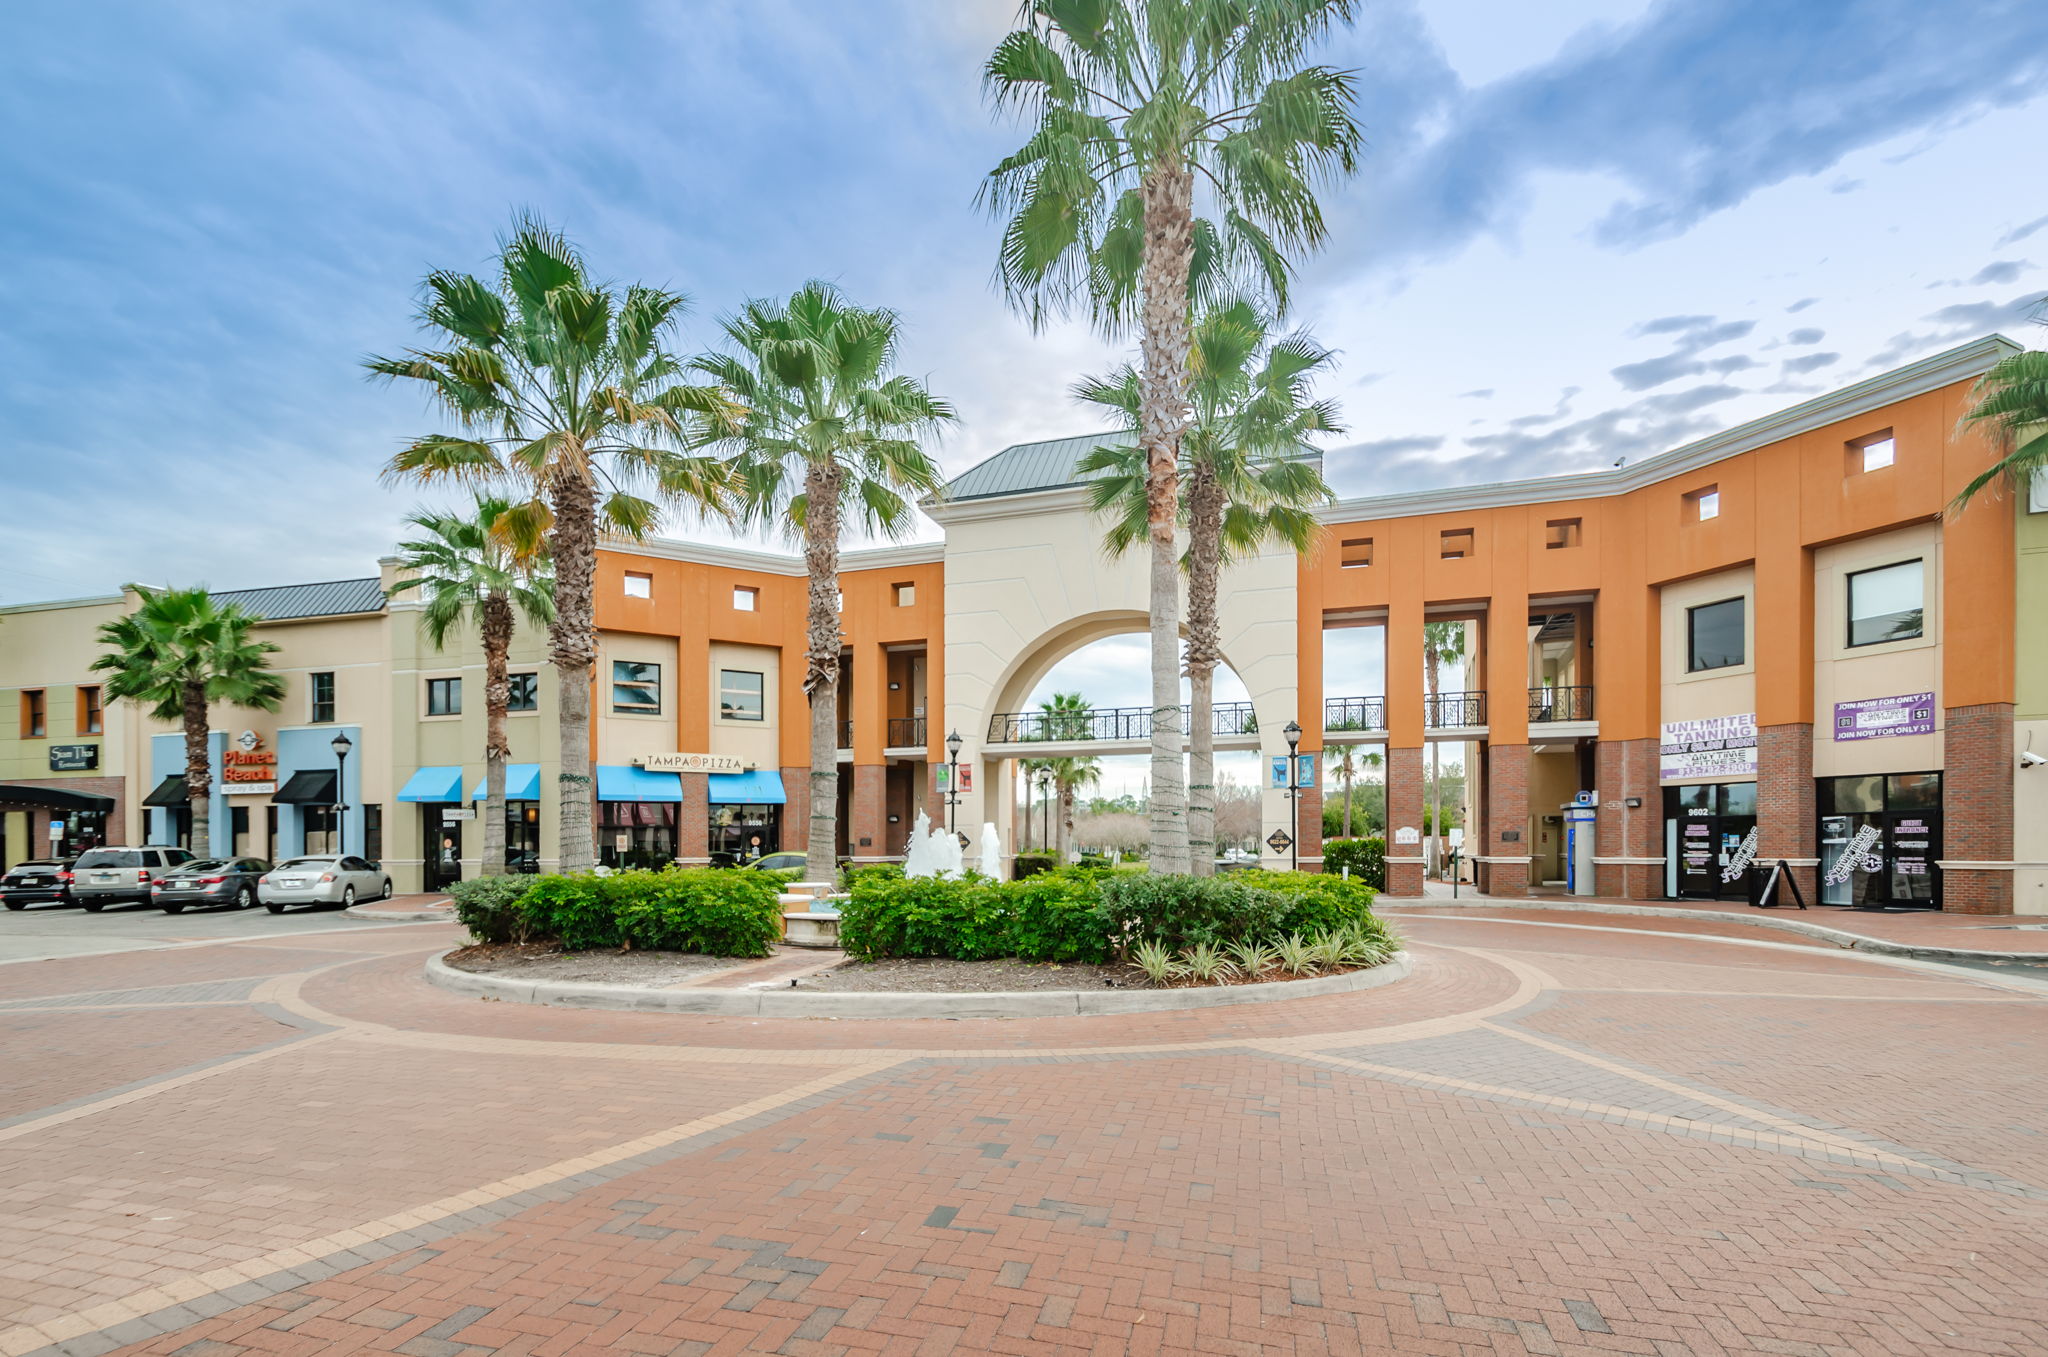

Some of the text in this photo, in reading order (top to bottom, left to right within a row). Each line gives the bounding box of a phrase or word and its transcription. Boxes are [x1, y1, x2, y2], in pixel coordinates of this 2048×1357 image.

[1838, 703, 1856, 711] JOIN
[1857, 700, 1878, 708] NOW
[1878, 698, 1896, 706] FOR
[1896, 695, 1920, 704] ONLY
[1921, 693, 1932, 701] $1
[1916, 710, 1927, 718] $1
[1674, 726, 1751, 744] TANNING
[1837, 724, 1931, 740] JOIN NOW FOR ONLY $1
[73, 746, 94, 759] Thai
[1661, 743, 1690, 755] ONLY
[1691, 750, 1746, 761] ANYTIME
[223, 751, 273, 764] Planet
[648, 755, 690, 767] TAMPA
[702, 758, 741, 769] PIZZA
[1692, 757, 1746, 767] FITNESS
[223, 766, 273, 781] Beach
[1688, 808, 1709, 816] 9602
[1833, 824, 1876, 873] ANYTIME
[1840, 830, 1882, 877] FITNESS
